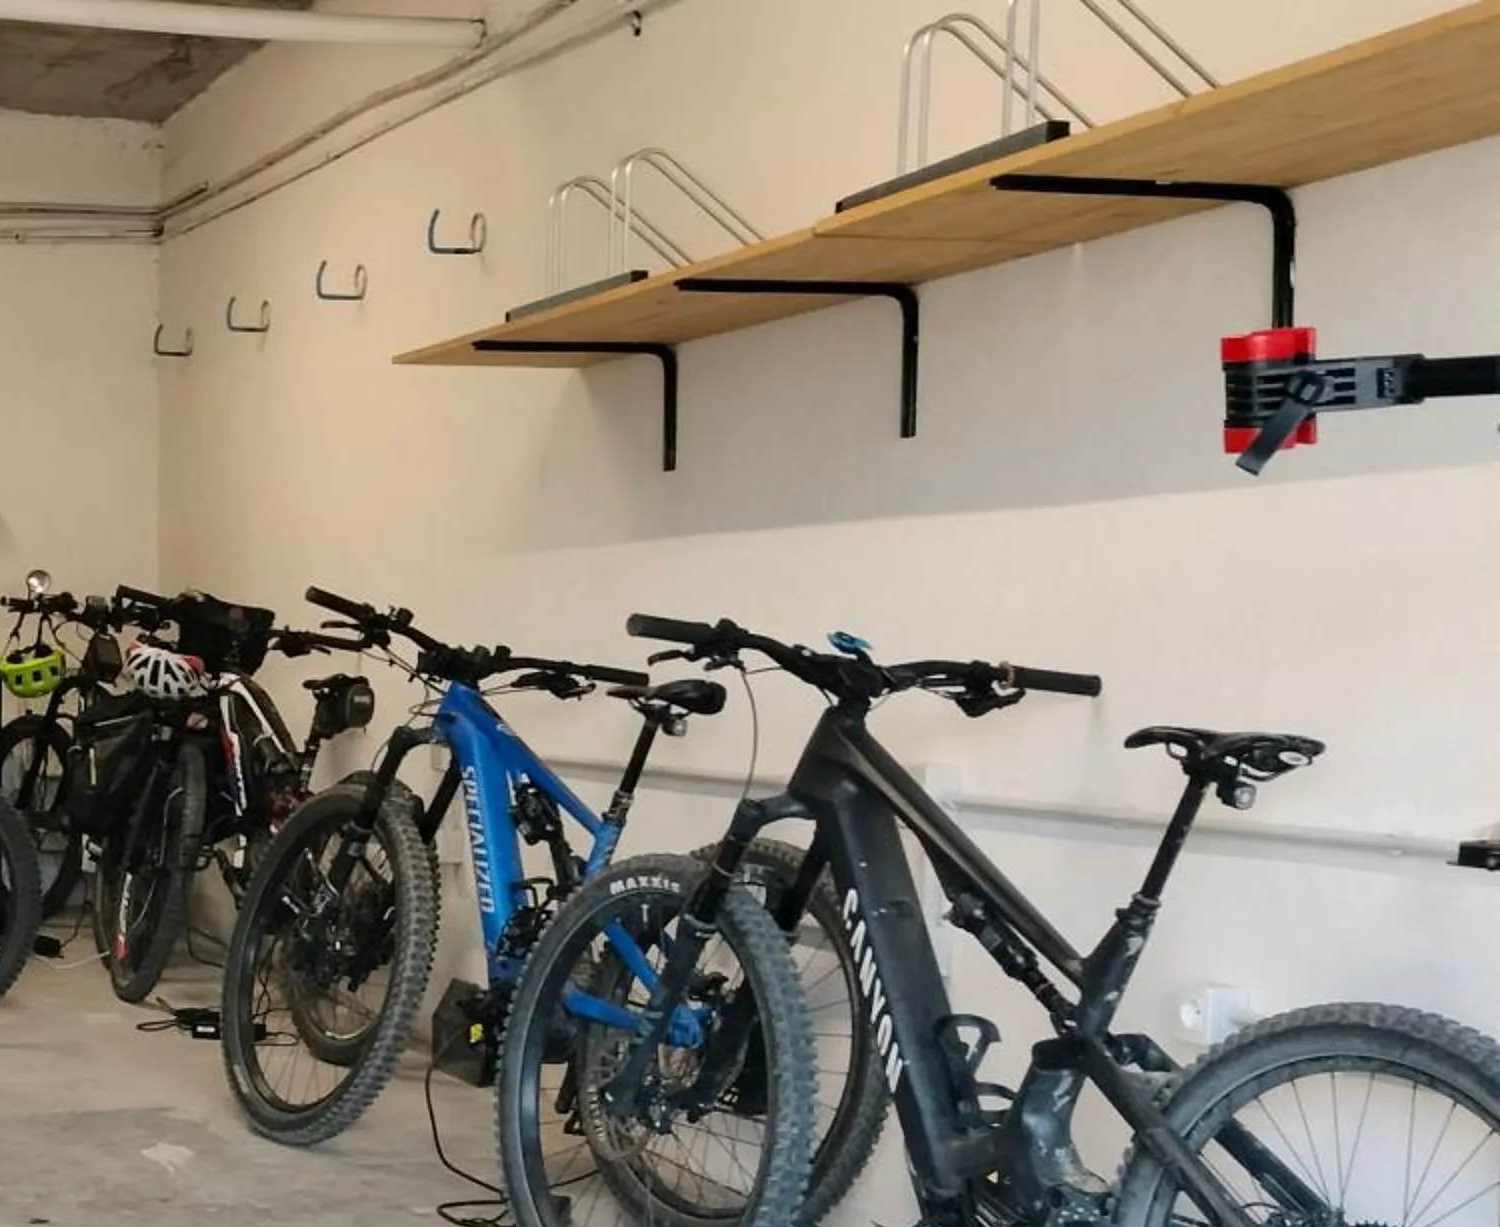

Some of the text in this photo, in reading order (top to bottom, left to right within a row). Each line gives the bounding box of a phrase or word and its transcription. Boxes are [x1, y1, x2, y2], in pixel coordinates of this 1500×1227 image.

[462, 765, 495, 914] SPECIALIZED
[610, 875, 680, 895] MAXXIS
[843, 888, 903, 1093] CANYON
